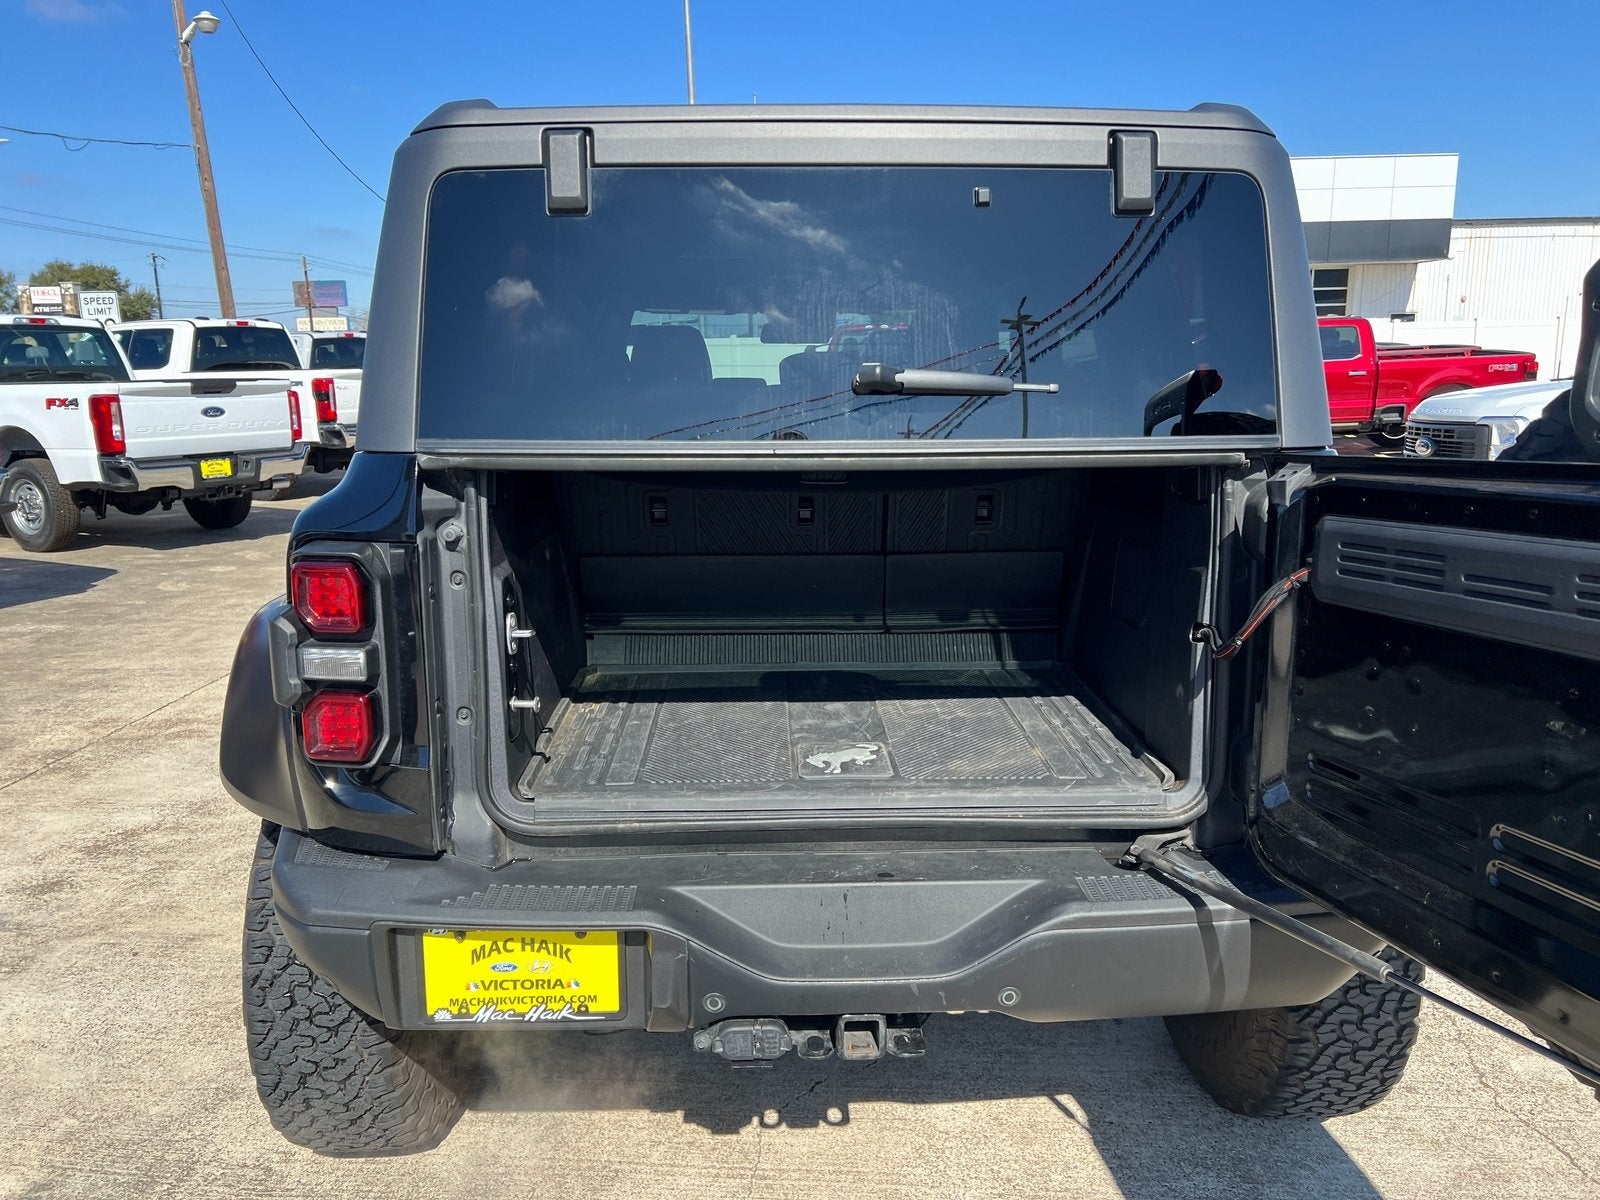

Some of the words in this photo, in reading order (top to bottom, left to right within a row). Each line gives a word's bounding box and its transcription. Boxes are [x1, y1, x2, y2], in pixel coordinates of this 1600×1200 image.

[83, 297, 114, 306] SPEED
[87, 307, 112, 315] LIMIT
[45, 398, 79, 410] FX4
[135, 422, 222, 435] SUPER
[227, 418, 284, 430] DUTY
[471, 938, 515, 965] MAC
[521, 937, 572, 964] HAIK
[493, 962, 516, 973] Ford
[480, 978, 566, 991] VICTORIA
[449, 994, 597, 1008] MACHAIKVICTORIA.COM
[473, 1004, 522, 1023] Mac
[524, 1002, 577, 1022] Haik
